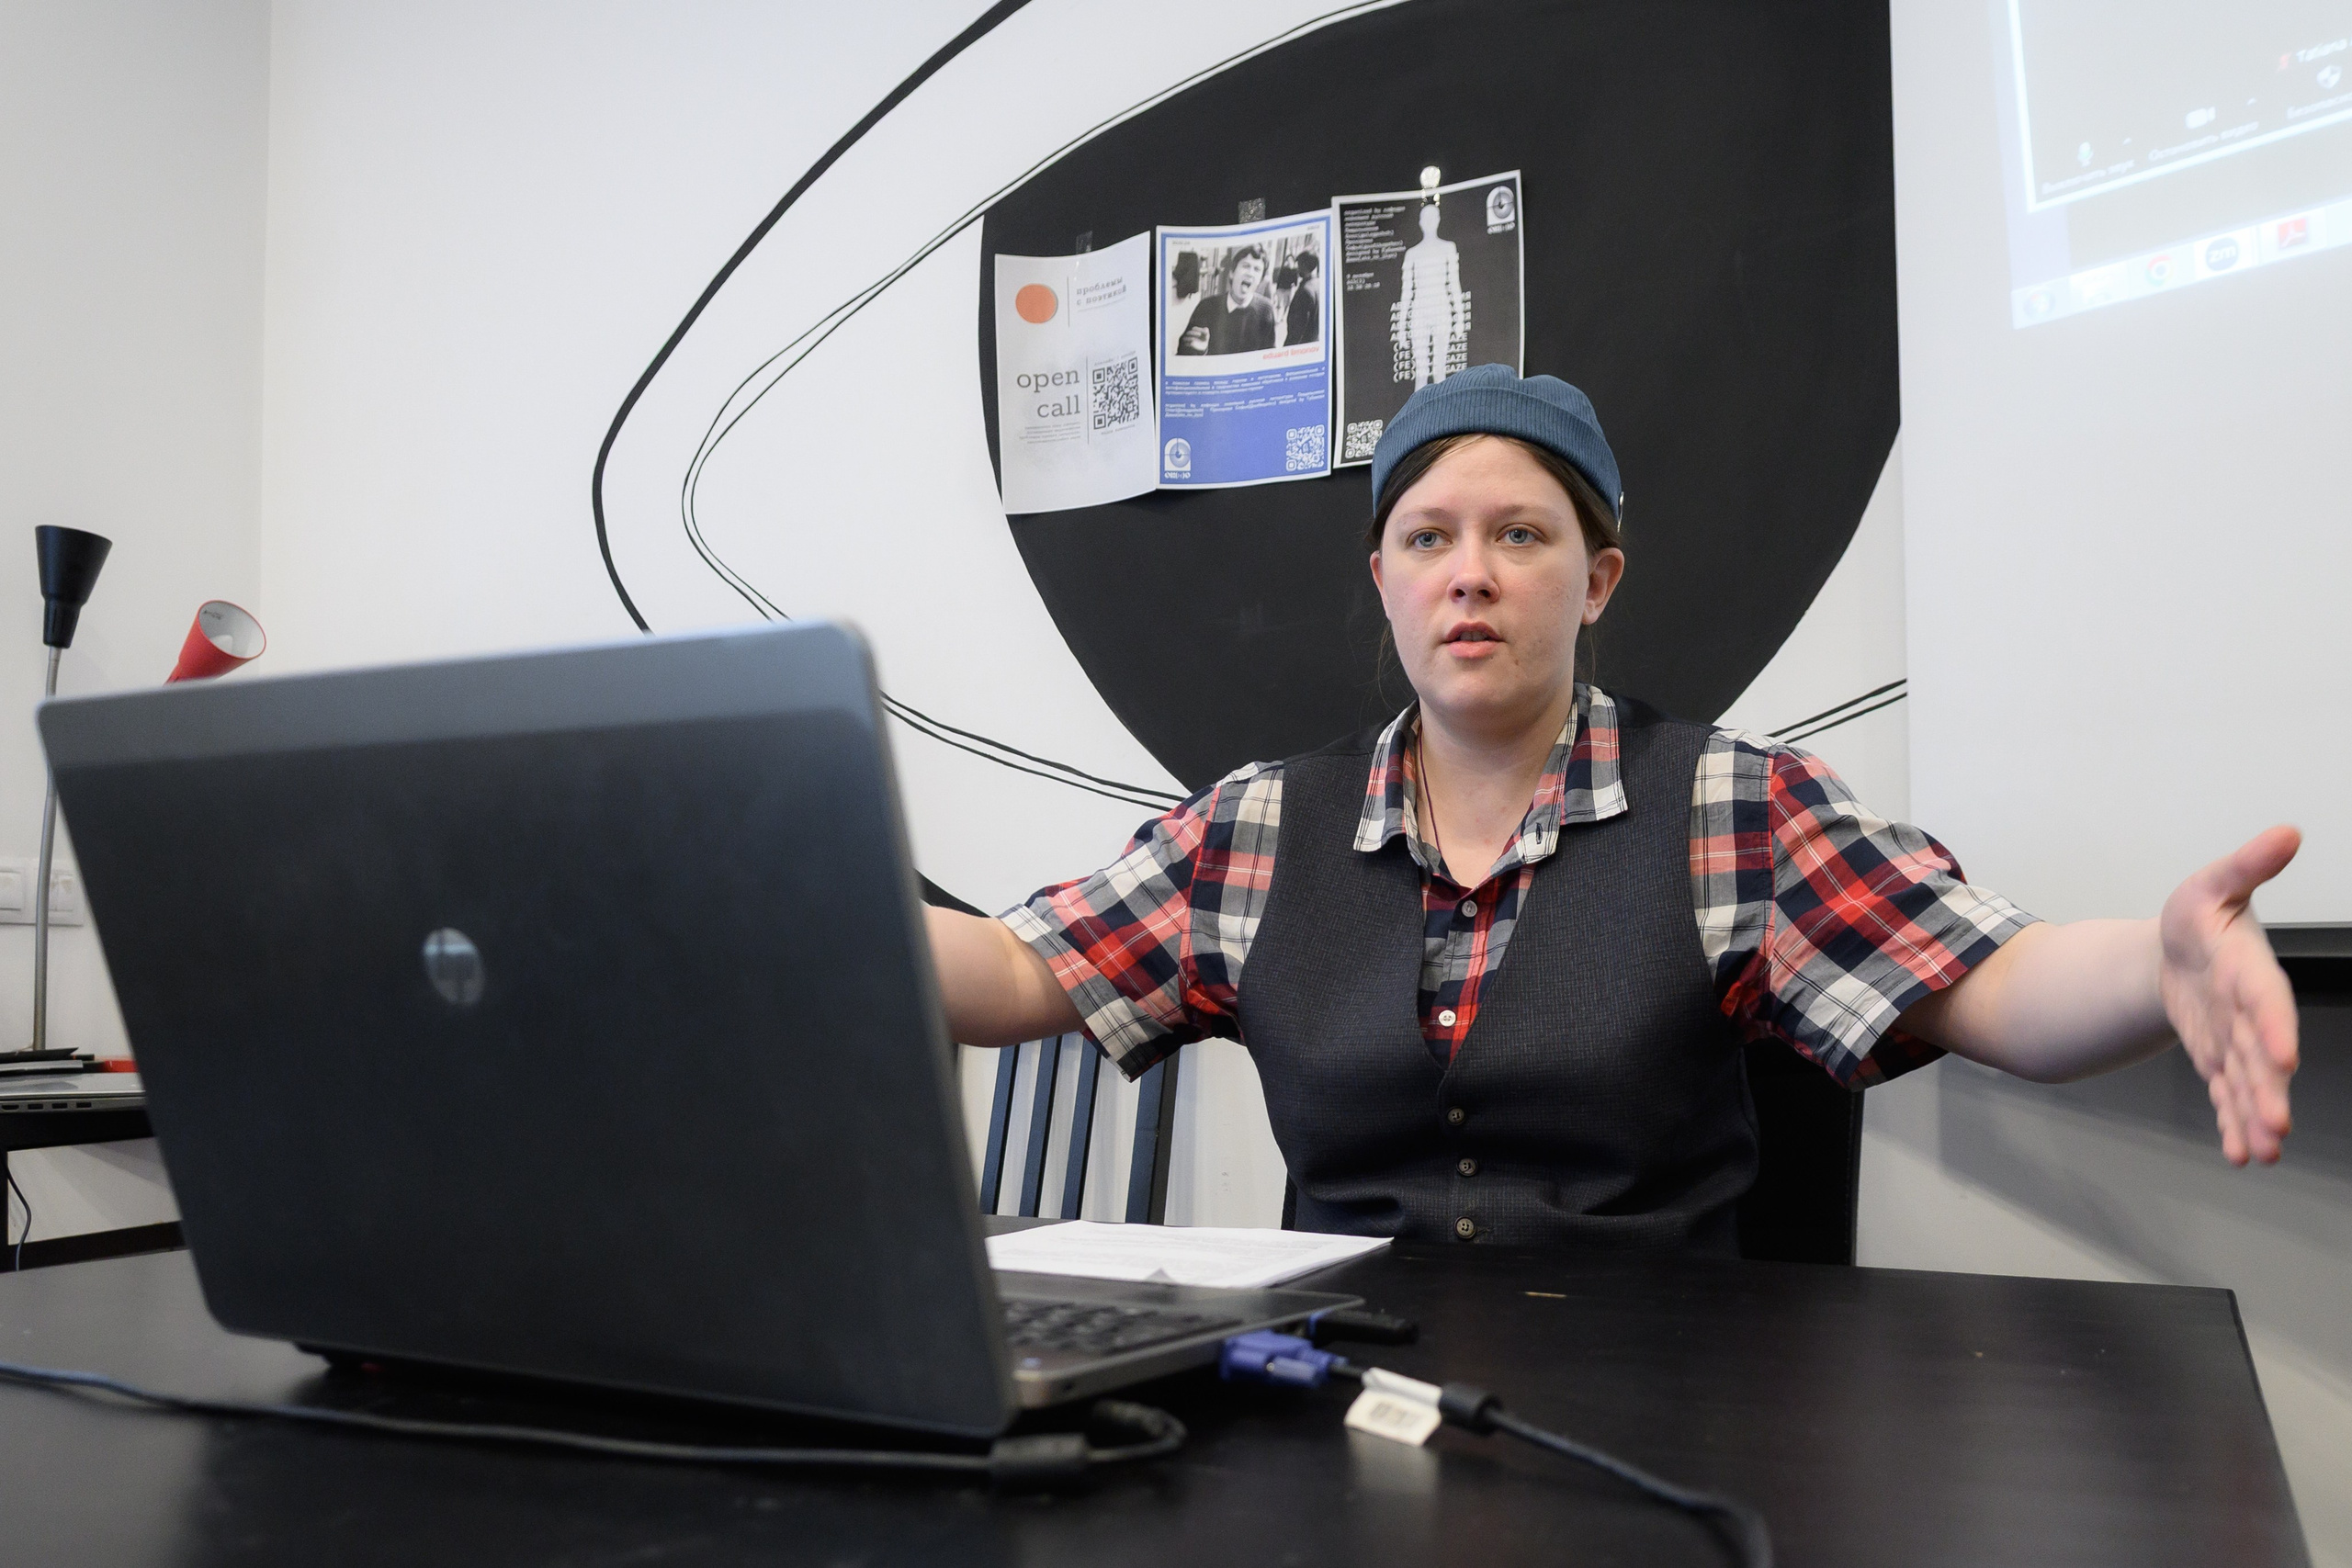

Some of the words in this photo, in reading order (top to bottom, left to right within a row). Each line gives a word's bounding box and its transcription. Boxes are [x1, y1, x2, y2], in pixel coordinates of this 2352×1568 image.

[2209, 245, 2236, 264] zm
[1076, 276, 1124, 296] проблемы
[1086, 284, 1127, 304] поэтикой
[1017, 369, 1080, 393] open
[1037, 395, 1080, 418] call
